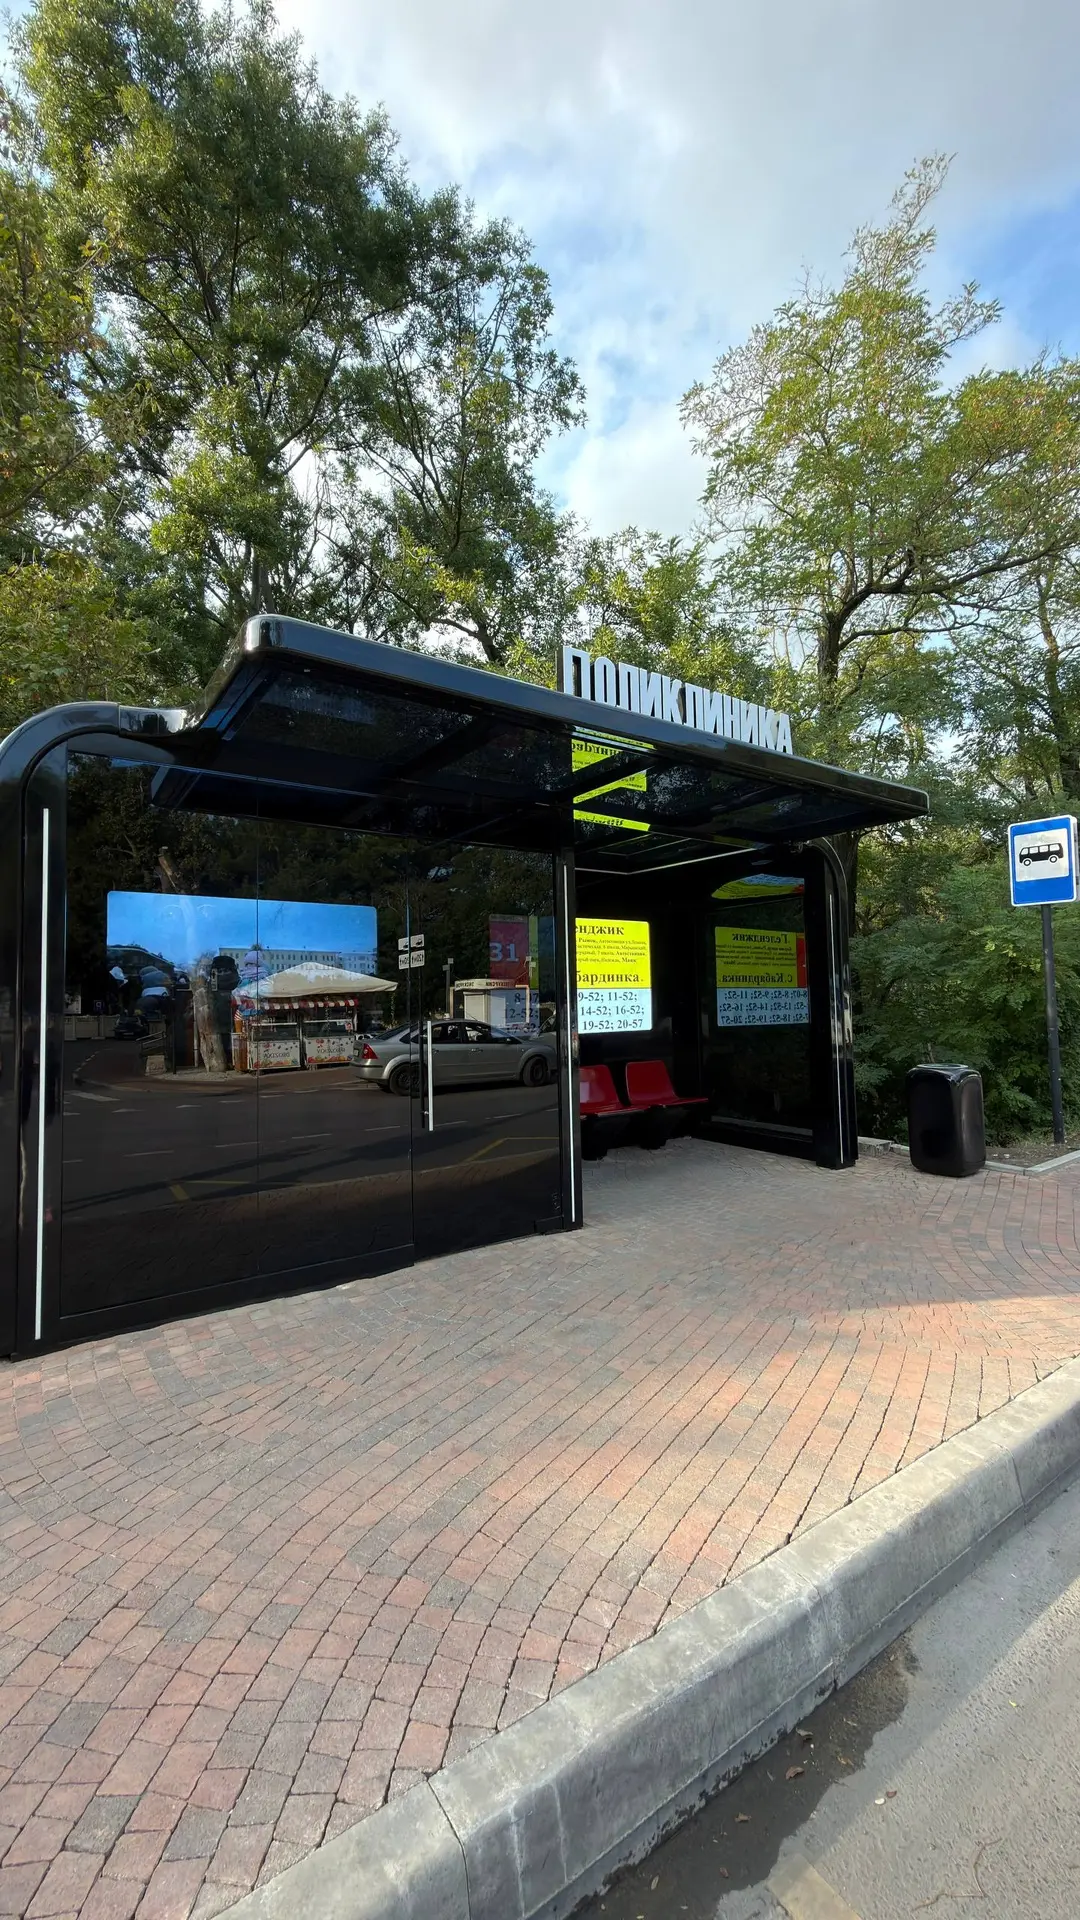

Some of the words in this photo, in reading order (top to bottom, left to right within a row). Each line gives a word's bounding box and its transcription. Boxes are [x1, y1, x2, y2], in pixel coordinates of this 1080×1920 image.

[562, 645, 794, 755] ПОЛИКЛИНИКА
[608, 992, 638, 1002] 11-52;
[580, 1006, 612, 1016] 14-52;
[616, 1005, 645, 1016] 16-52;
[583, 1020, 614, 1030] 19-52;
[618, 1019, 643, 1029] 20-57
